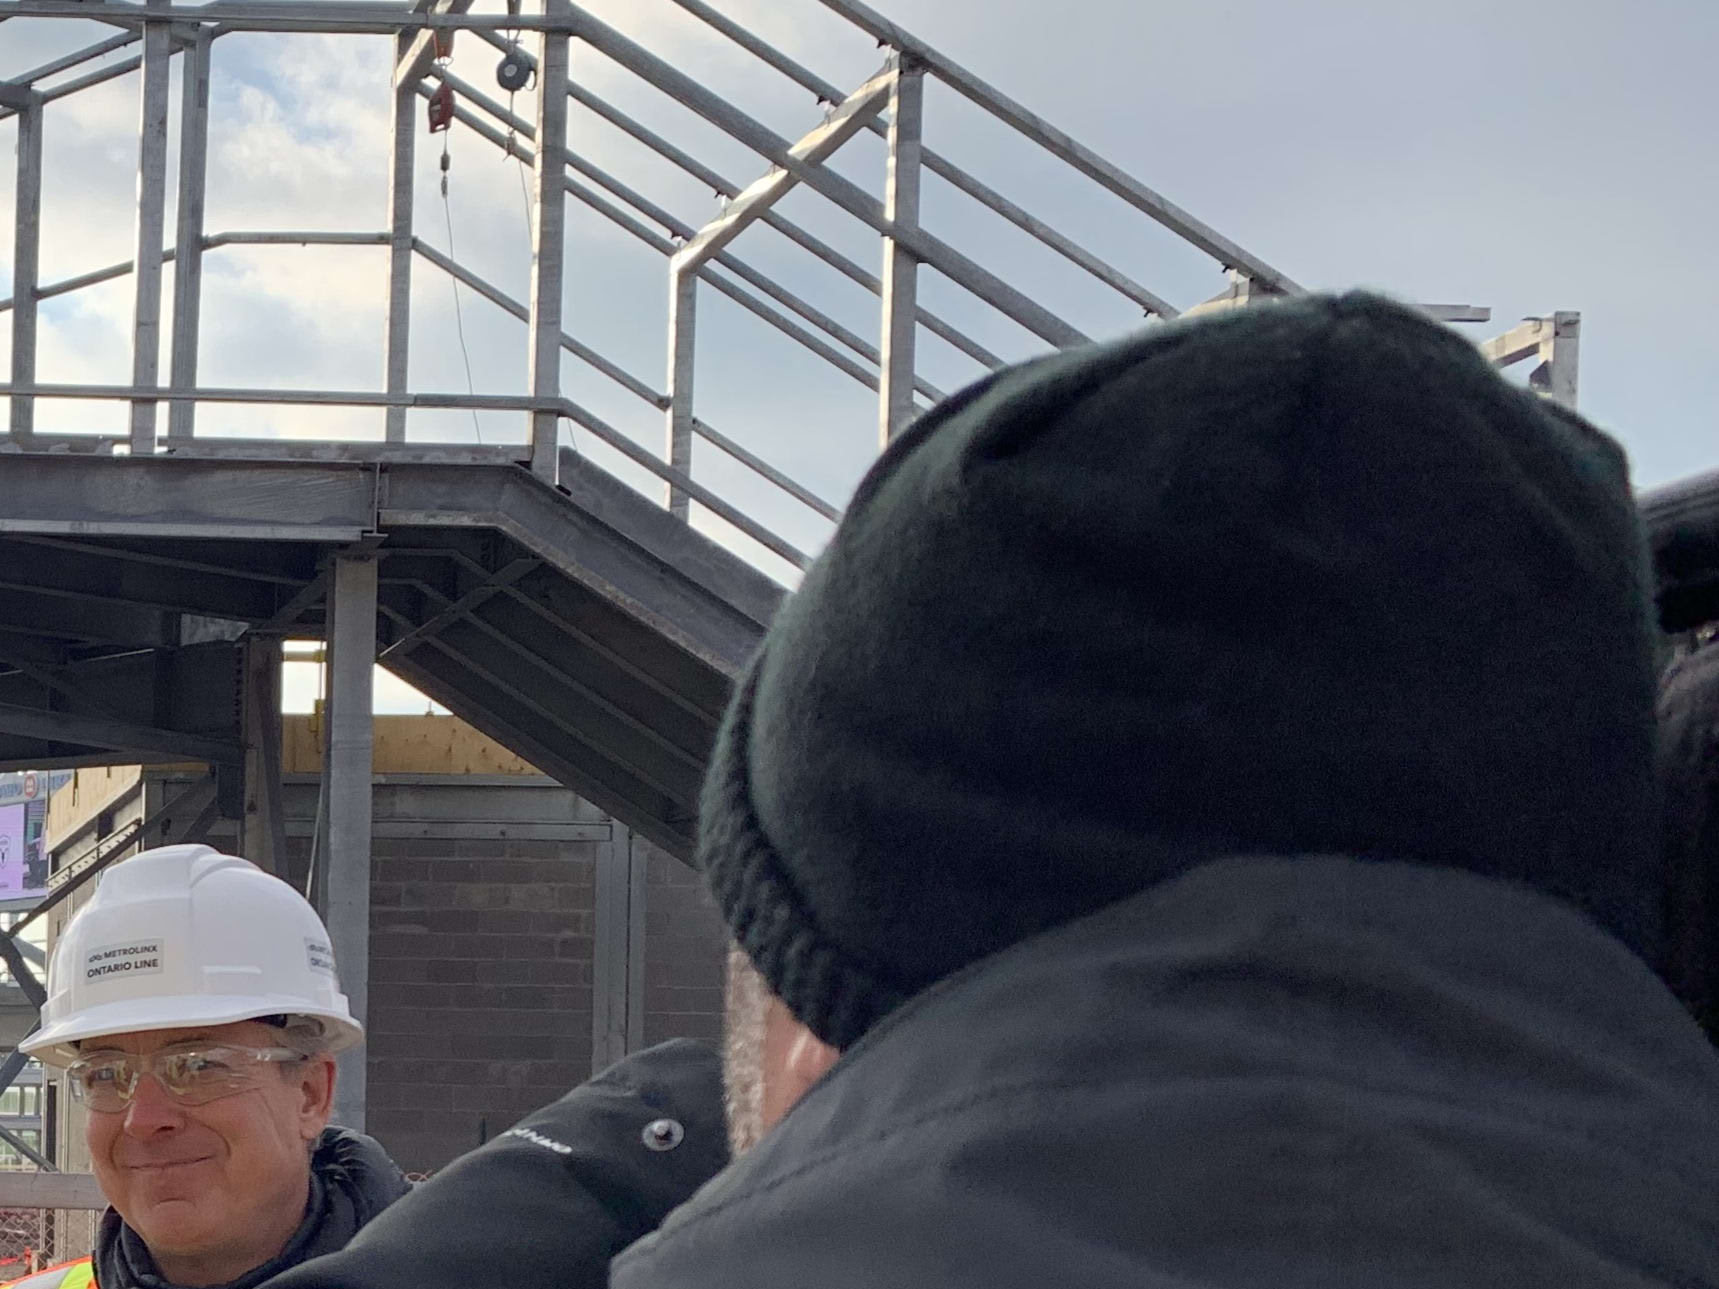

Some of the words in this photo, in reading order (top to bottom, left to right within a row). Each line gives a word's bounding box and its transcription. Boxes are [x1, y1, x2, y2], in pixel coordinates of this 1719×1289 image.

[103, 944, 158, 959] METROLINX
[86, 961, 132, 978] ONTARIO
[133, 958, 159, 969] LINE
